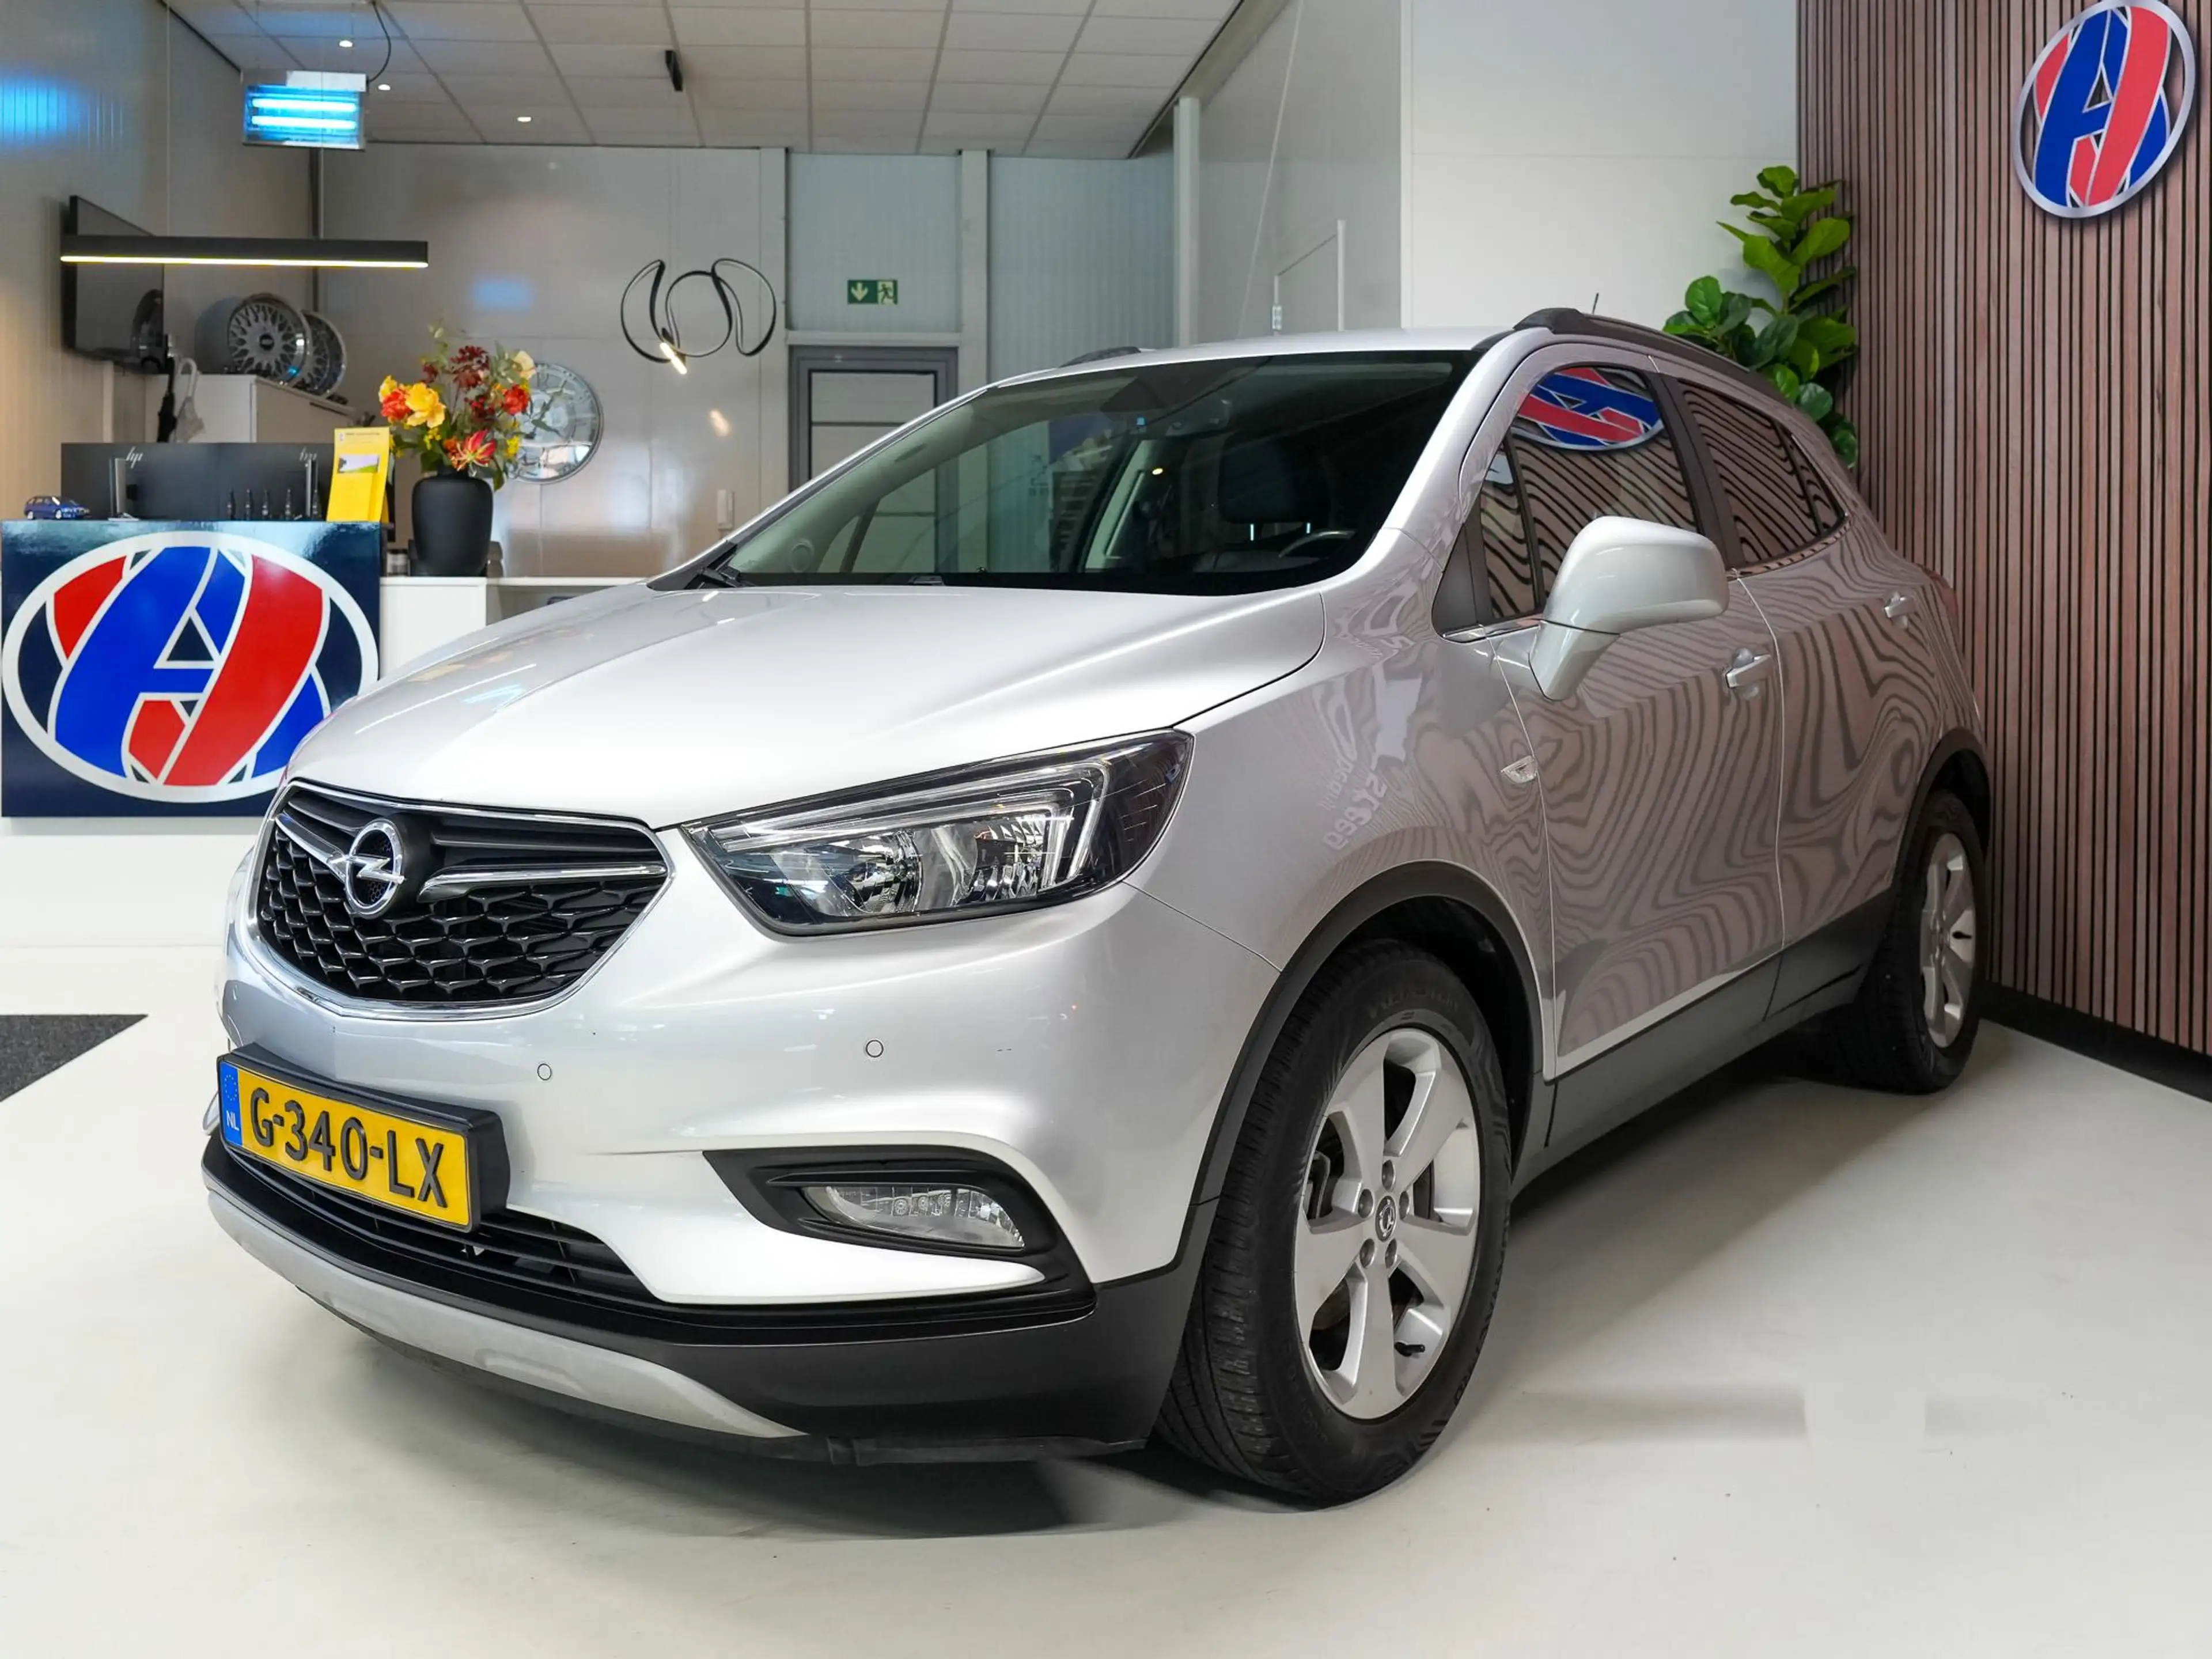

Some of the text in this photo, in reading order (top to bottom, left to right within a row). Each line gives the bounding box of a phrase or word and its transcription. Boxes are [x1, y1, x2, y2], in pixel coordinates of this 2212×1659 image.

[126, 446, 143, 469] hp
[226, 1109, 240, 1131] NL
[250, 1086, 448, 1209] G-340-LX
